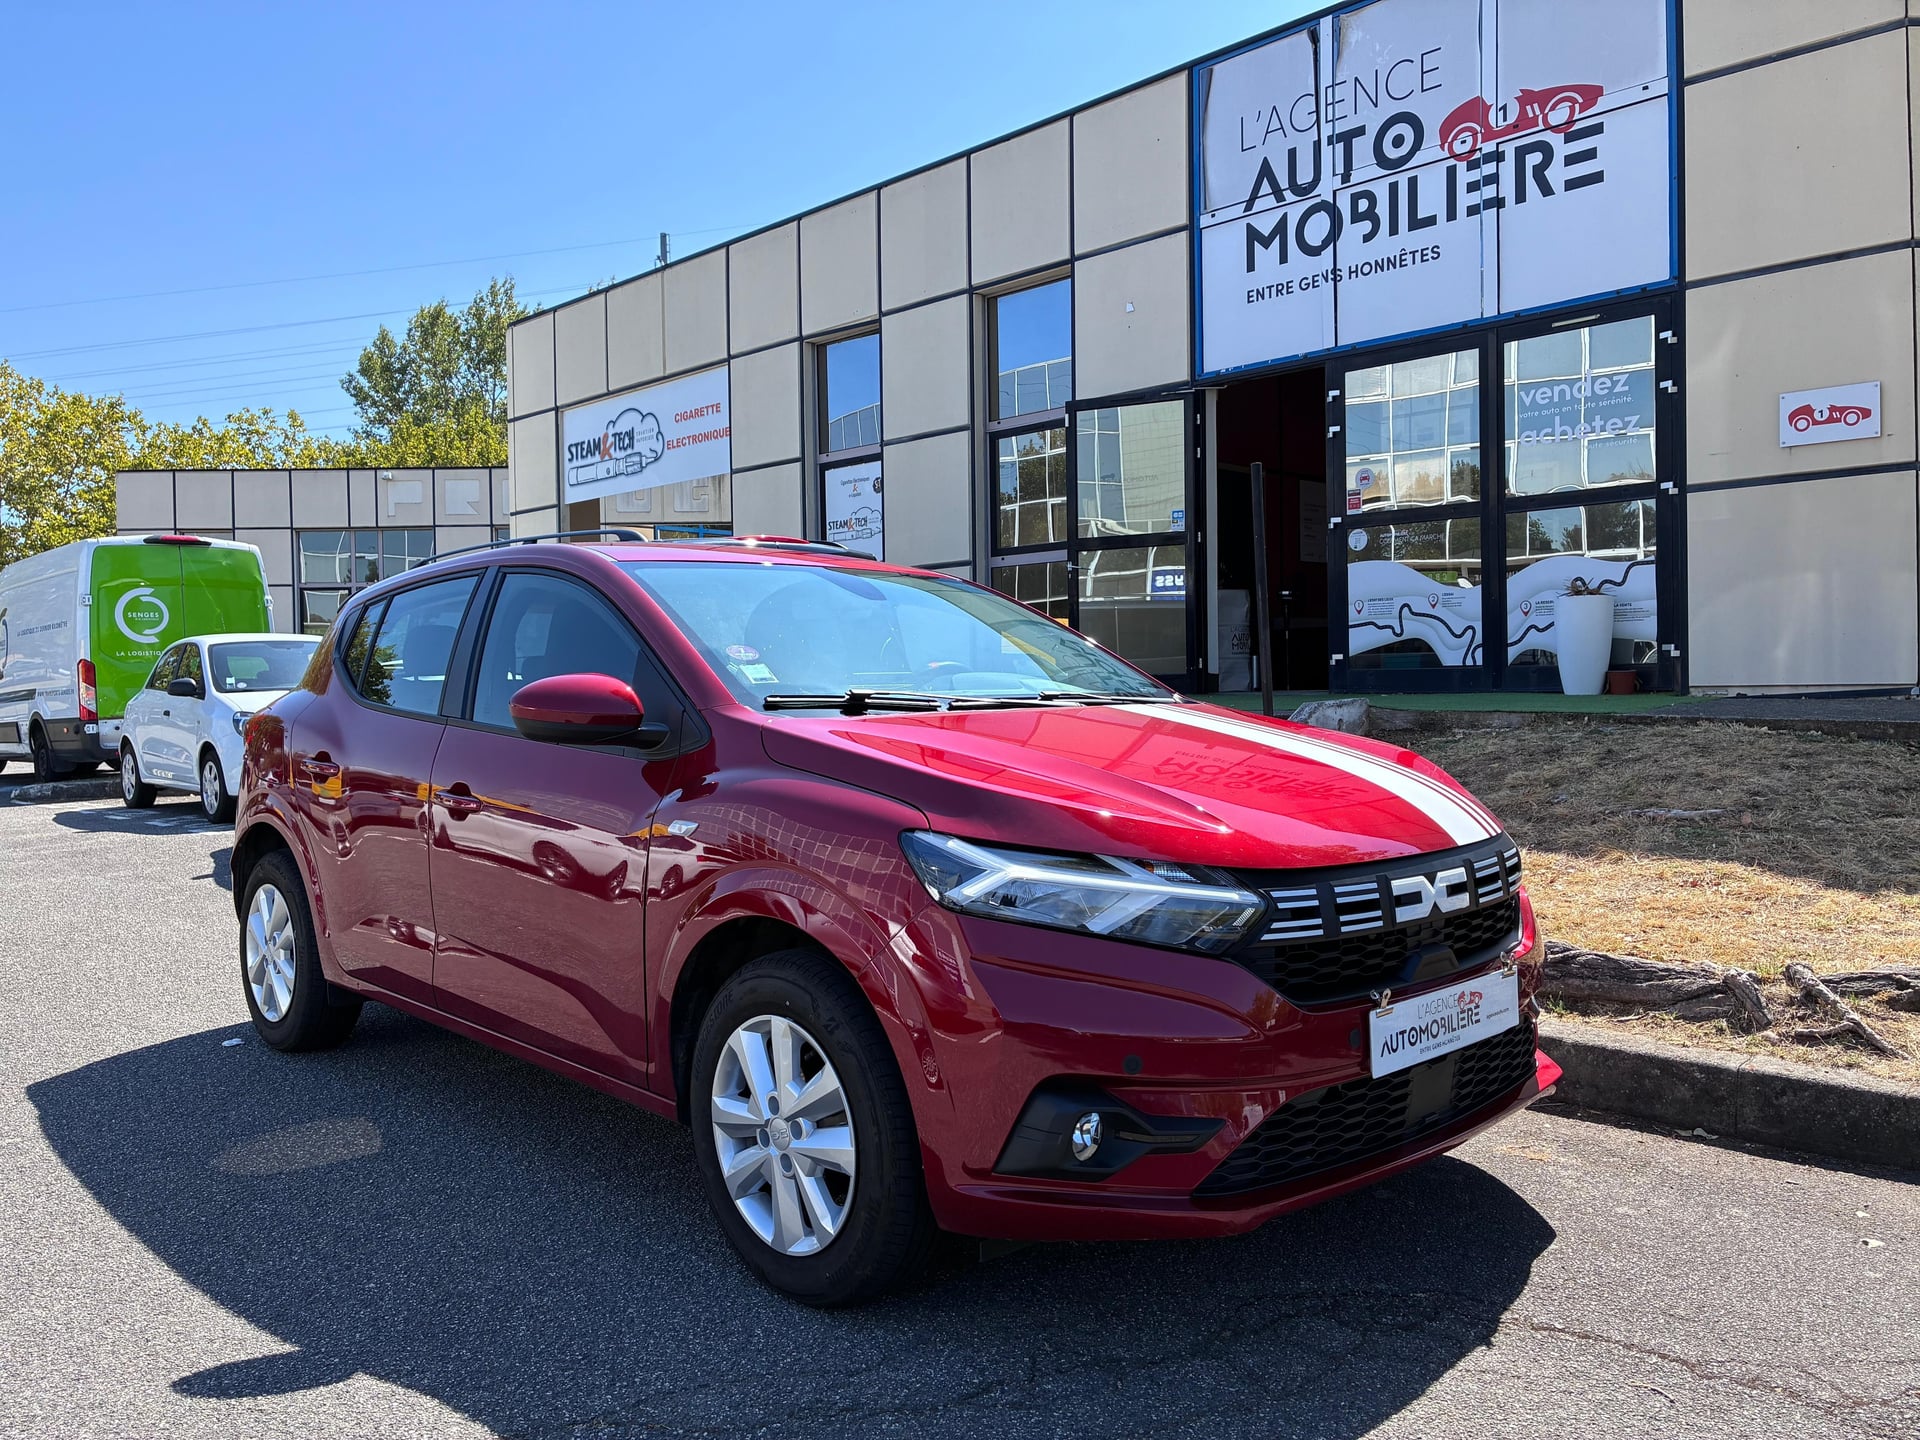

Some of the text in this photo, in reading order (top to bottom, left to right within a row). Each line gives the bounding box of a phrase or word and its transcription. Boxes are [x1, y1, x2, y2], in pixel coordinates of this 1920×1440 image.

[1241, 46, 1442, 152] L'AGENCE
[1243, 110, 1425, 213] AUTO
[1246, 244, 1441, 304] ENTRE GENS HONNÊTES
[1519, 369, 1630, 407] vendez
[674, 402, 721, 424] CIGARETTE
[1519, 410, 1539, 418] votre
[1541, 407, 1560, 416] auto
[1562, 405, 1572, 413] en
[1574, 401, 1597, 411] toute
[666, 426, 731, 451] ELECTRONIQUE
[1519, 414, 1641, 447] achetez
[1417, 992, 1459, 1020] L'AGENCE
